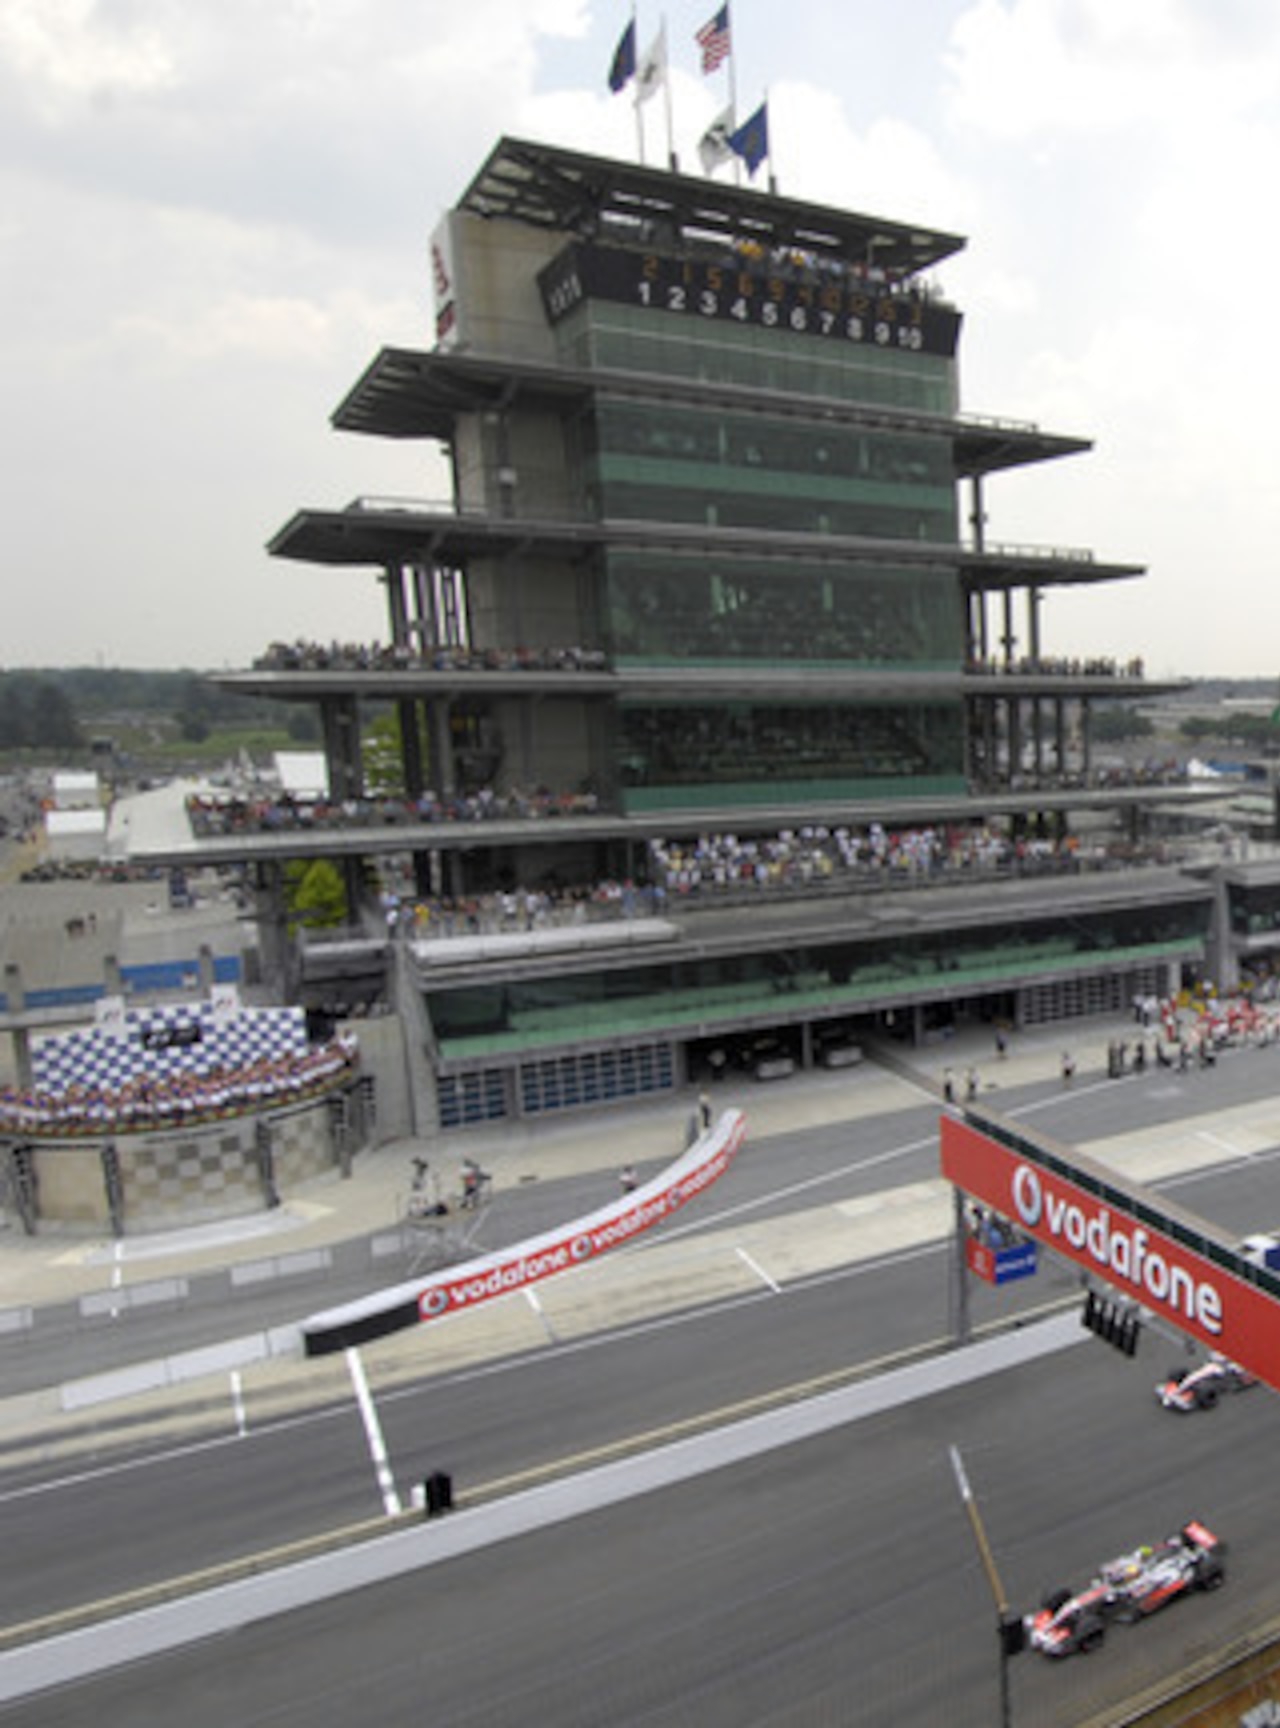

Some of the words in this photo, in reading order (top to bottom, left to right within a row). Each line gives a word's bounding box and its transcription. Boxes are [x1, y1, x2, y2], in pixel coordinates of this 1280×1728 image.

[638, 281, 651, 305] 1
[667, 286, 686, 311] 2
[699, 291, 718, 316] 3
[730, 298, 748, 320] 4
[762, 302, 778, 326] 5
[790, 306, 807, 331] 6
[819, 310, 836, 335] 7
[846, 317, 863, 341] 8
[874, 321, 891, 345] 9
[898, 325, 922, 350] 10
[593, 1197, 666, 1248] vodafone
[450, 1247, 569, 1303] vodafone
[1045, 1193, 1223, 1335] vodafone
